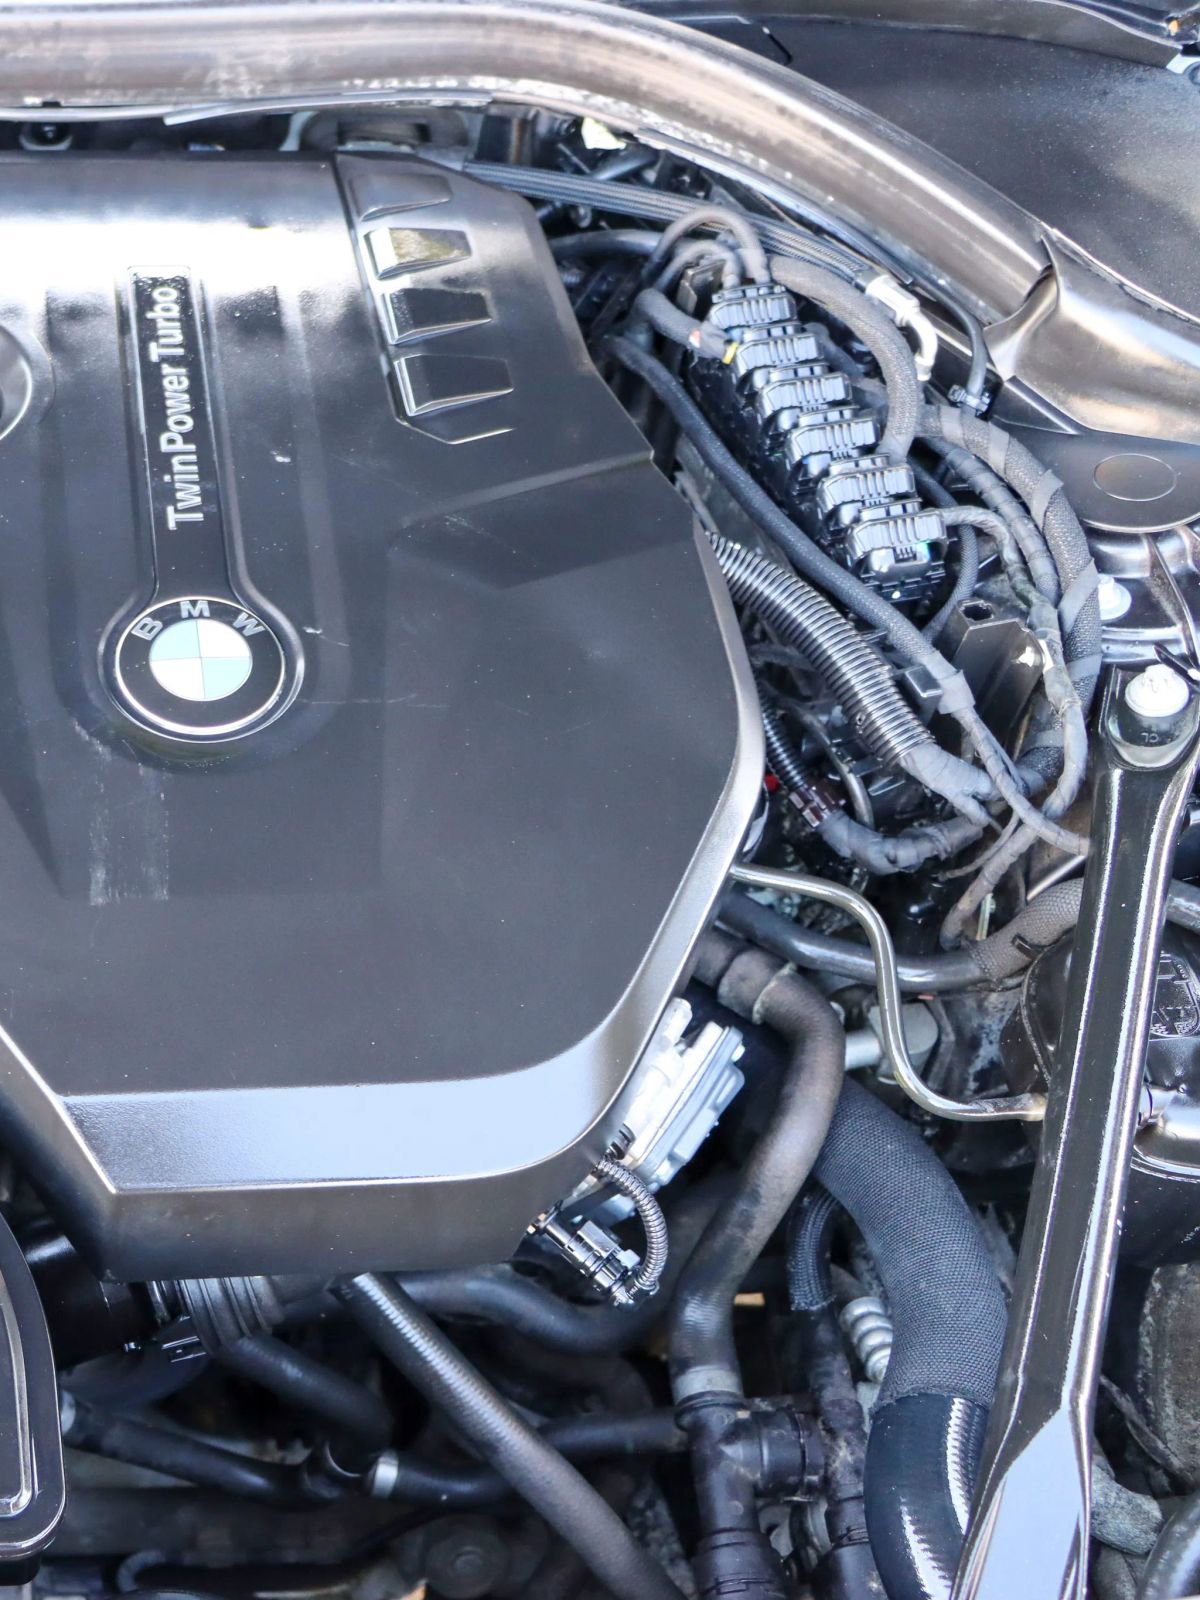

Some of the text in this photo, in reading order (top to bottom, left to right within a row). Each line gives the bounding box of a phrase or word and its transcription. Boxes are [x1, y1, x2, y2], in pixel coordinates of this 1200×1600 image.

[145, 287, 204, 530] TwinPower Turbo
[131, 600, 265, 641] BMW
